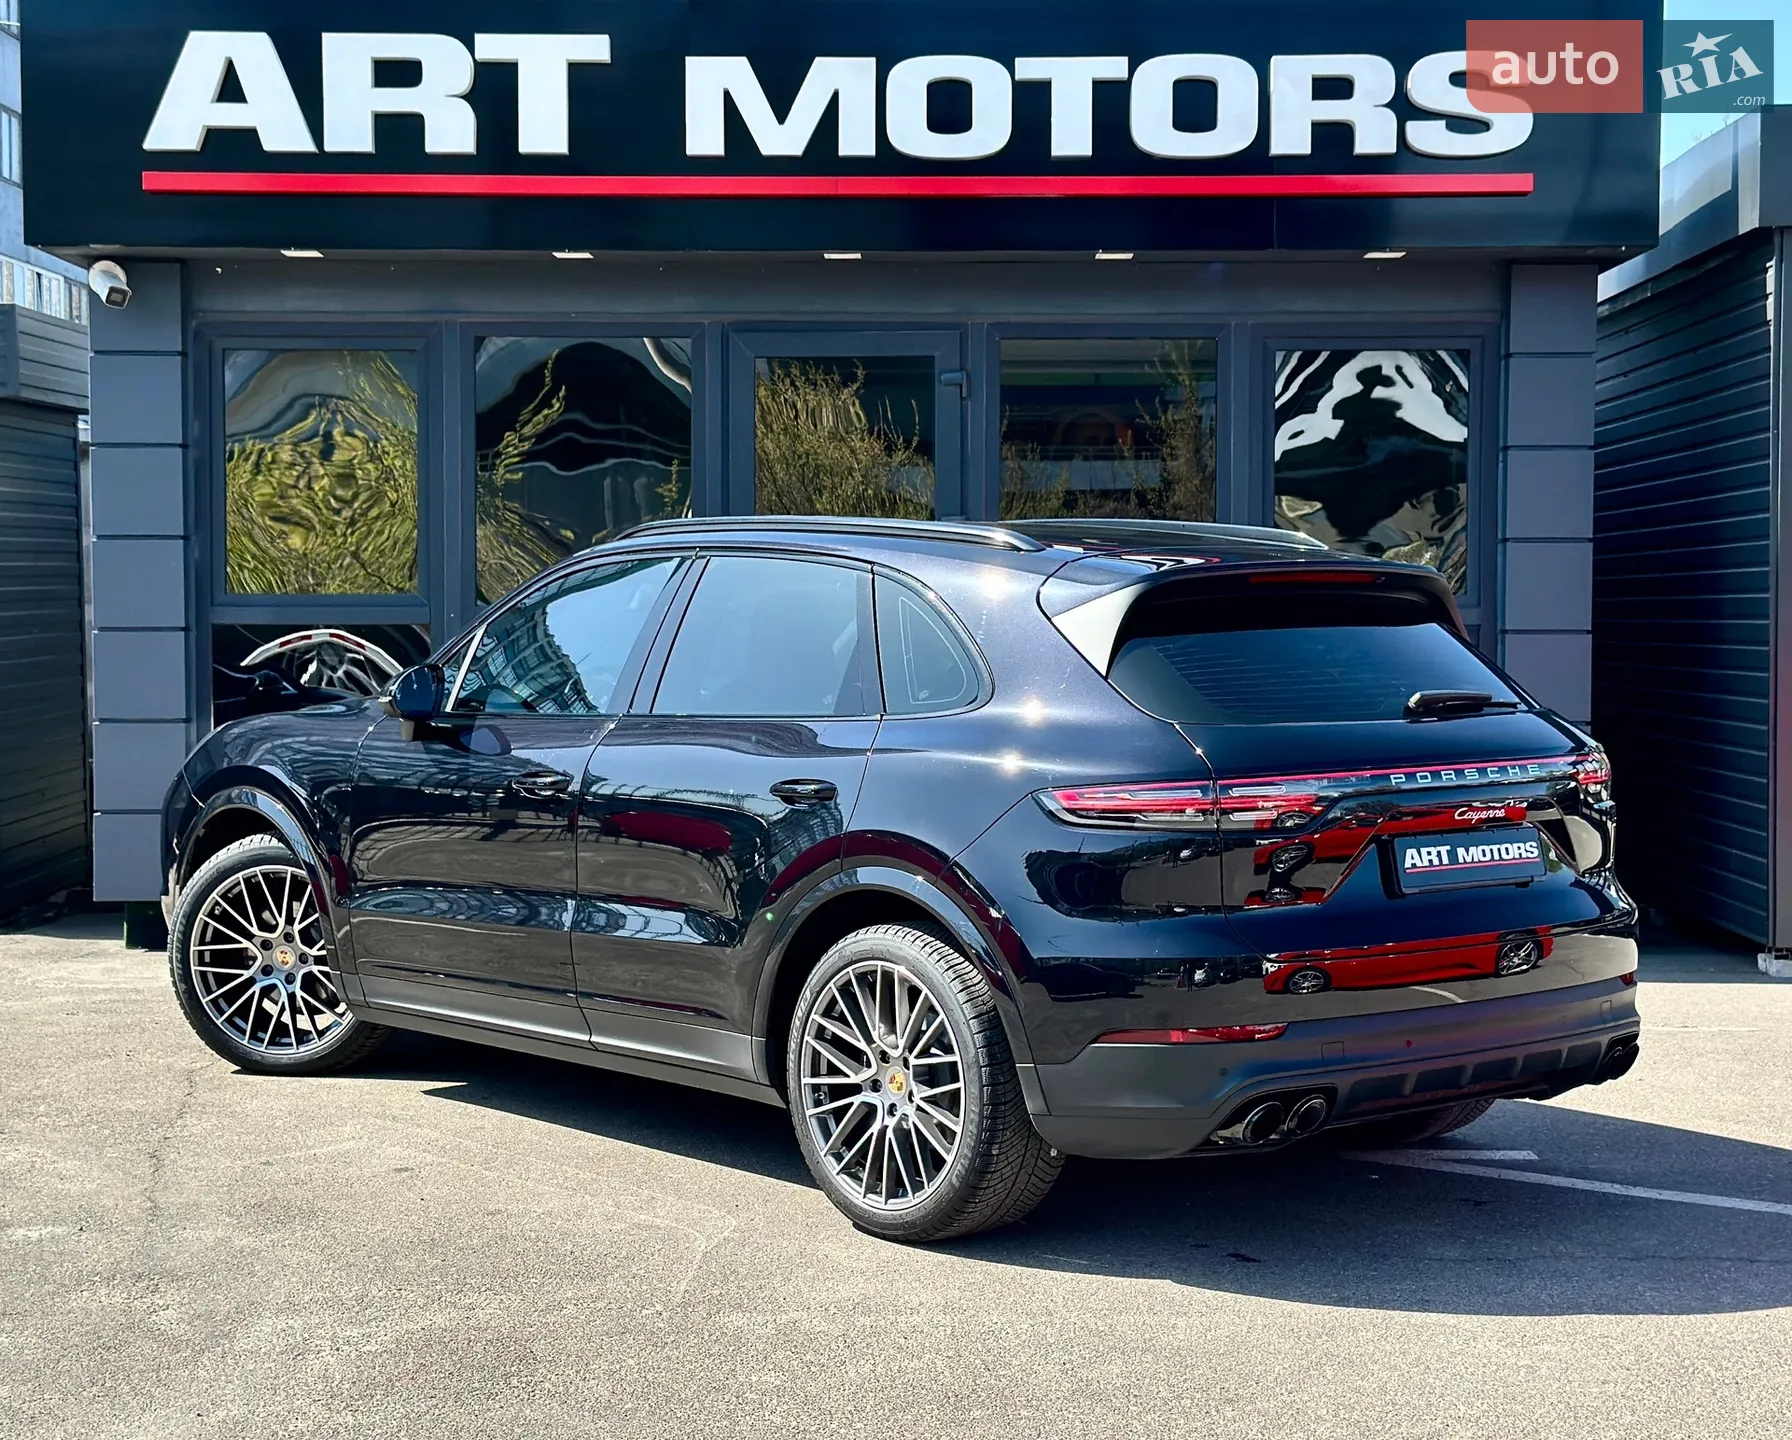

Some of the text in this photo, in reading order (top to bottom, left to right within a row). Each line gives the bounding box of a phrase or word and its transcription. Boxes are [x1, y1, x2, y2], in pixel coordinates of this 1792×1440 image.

[142, 30, 1533, 159] ART MOTORS
[1390, 764, 1541, 786] PORSCHE
[1454, 807, 1506, 824] Cayenne
[1404, 841, 1539, 869] ART MOTORS
